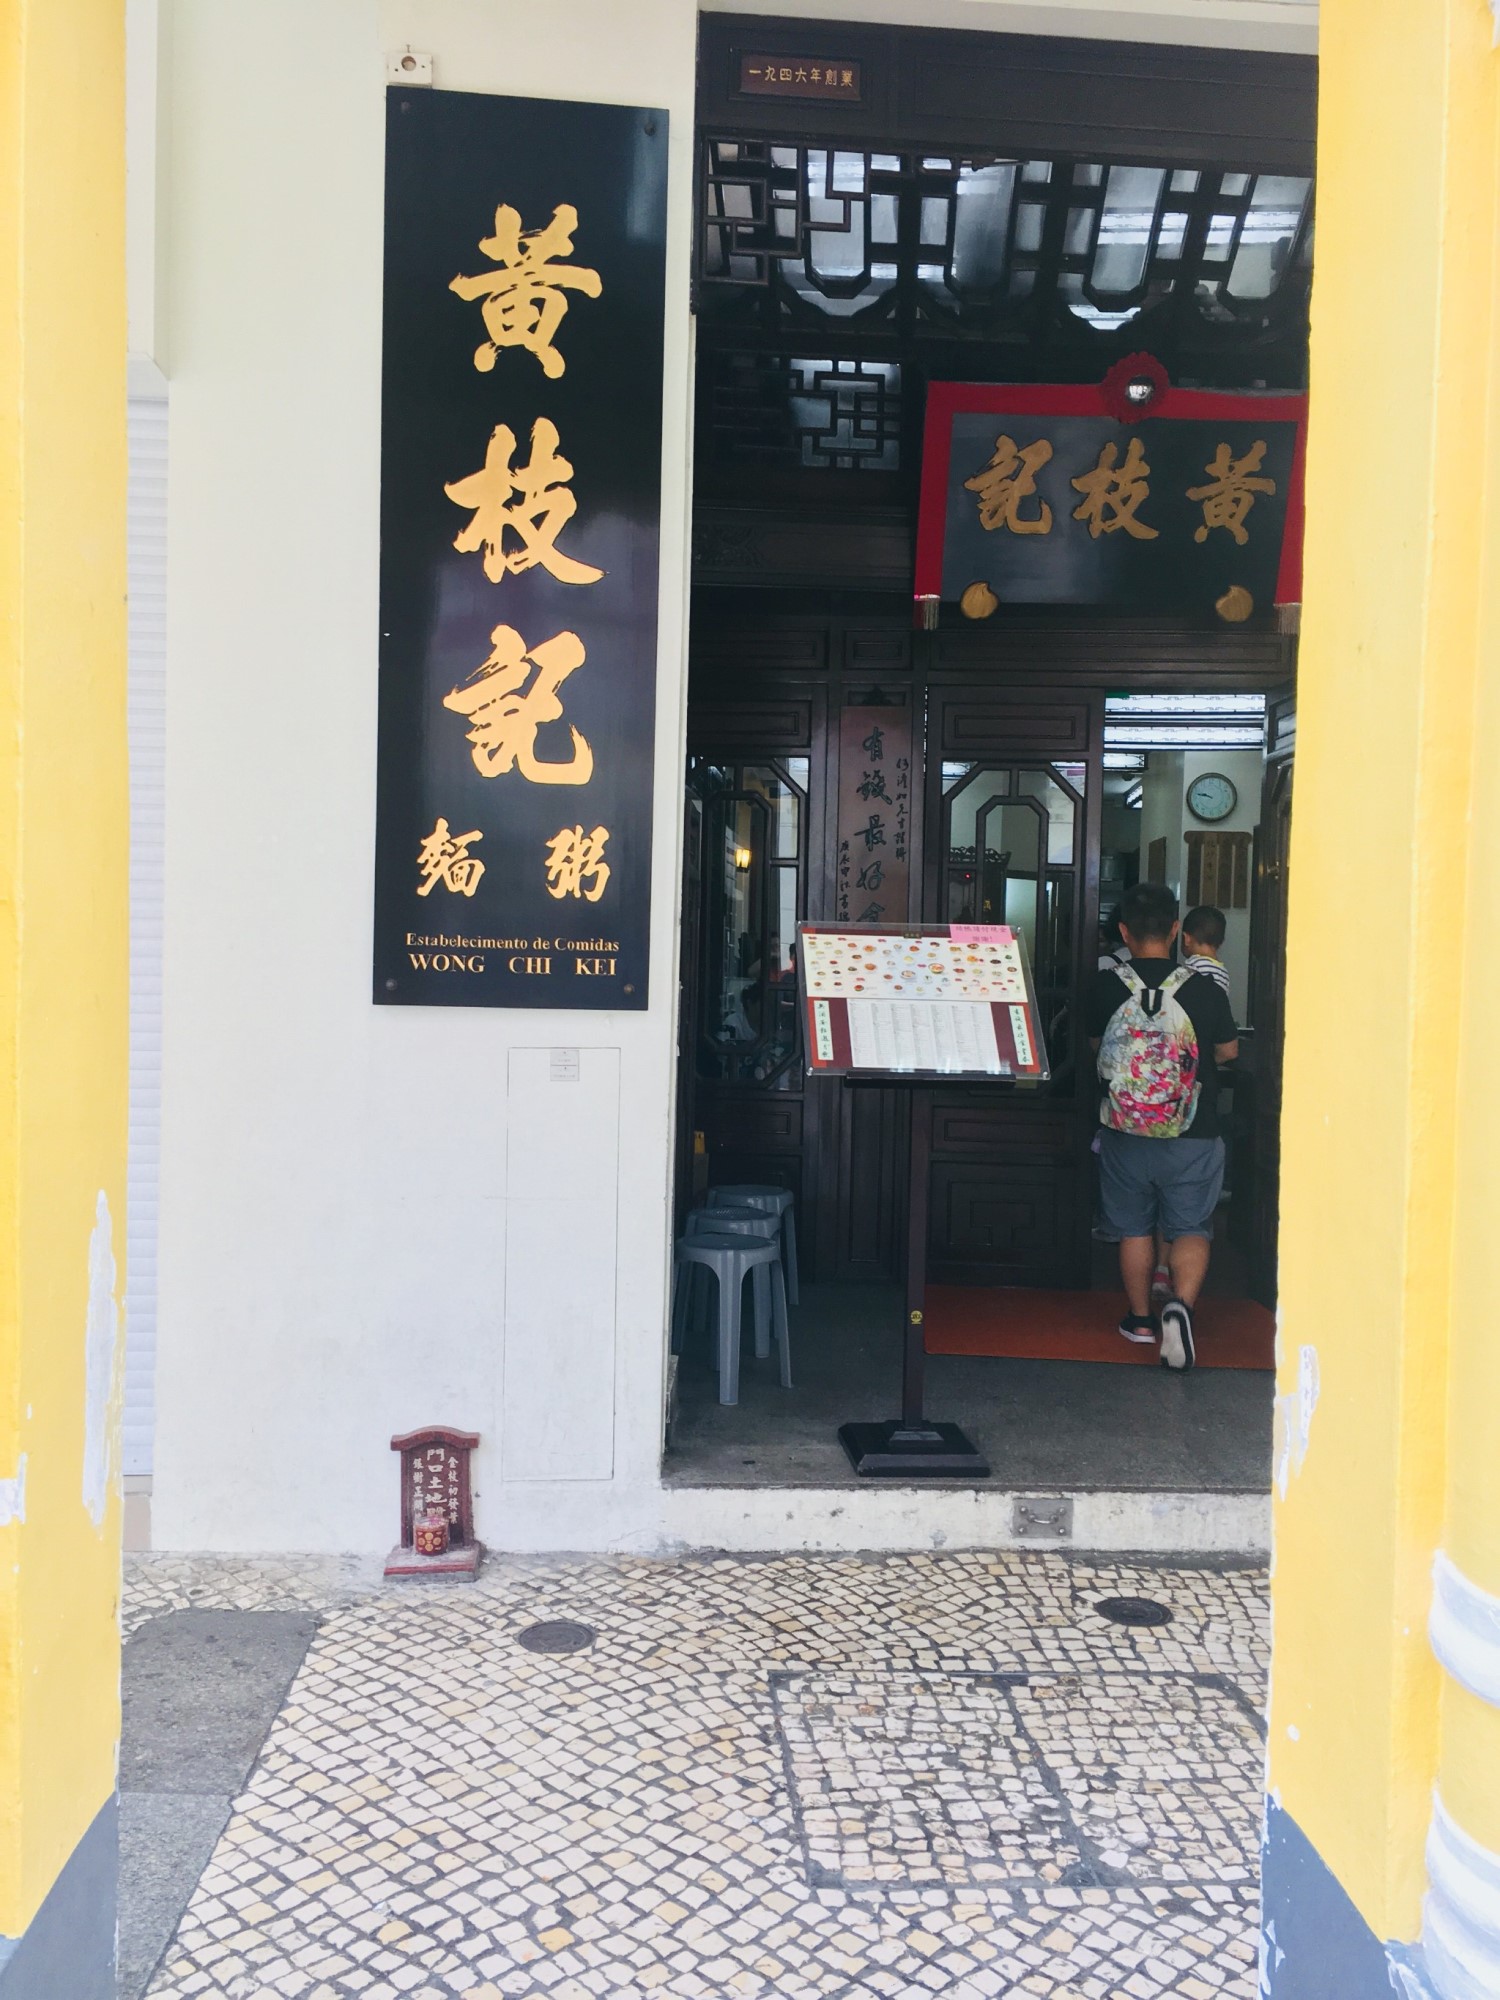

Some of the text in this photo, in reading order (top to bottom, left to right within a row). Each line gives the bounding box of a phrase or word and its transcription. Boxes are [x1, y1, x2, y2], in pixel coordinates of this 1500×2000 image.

[748, 65, 853, 87] 一九四六年創業
[405, 932, 620, 952] Estabelecimento de Comidas
[408, 953, 617, 976] WONG CHI KEI
